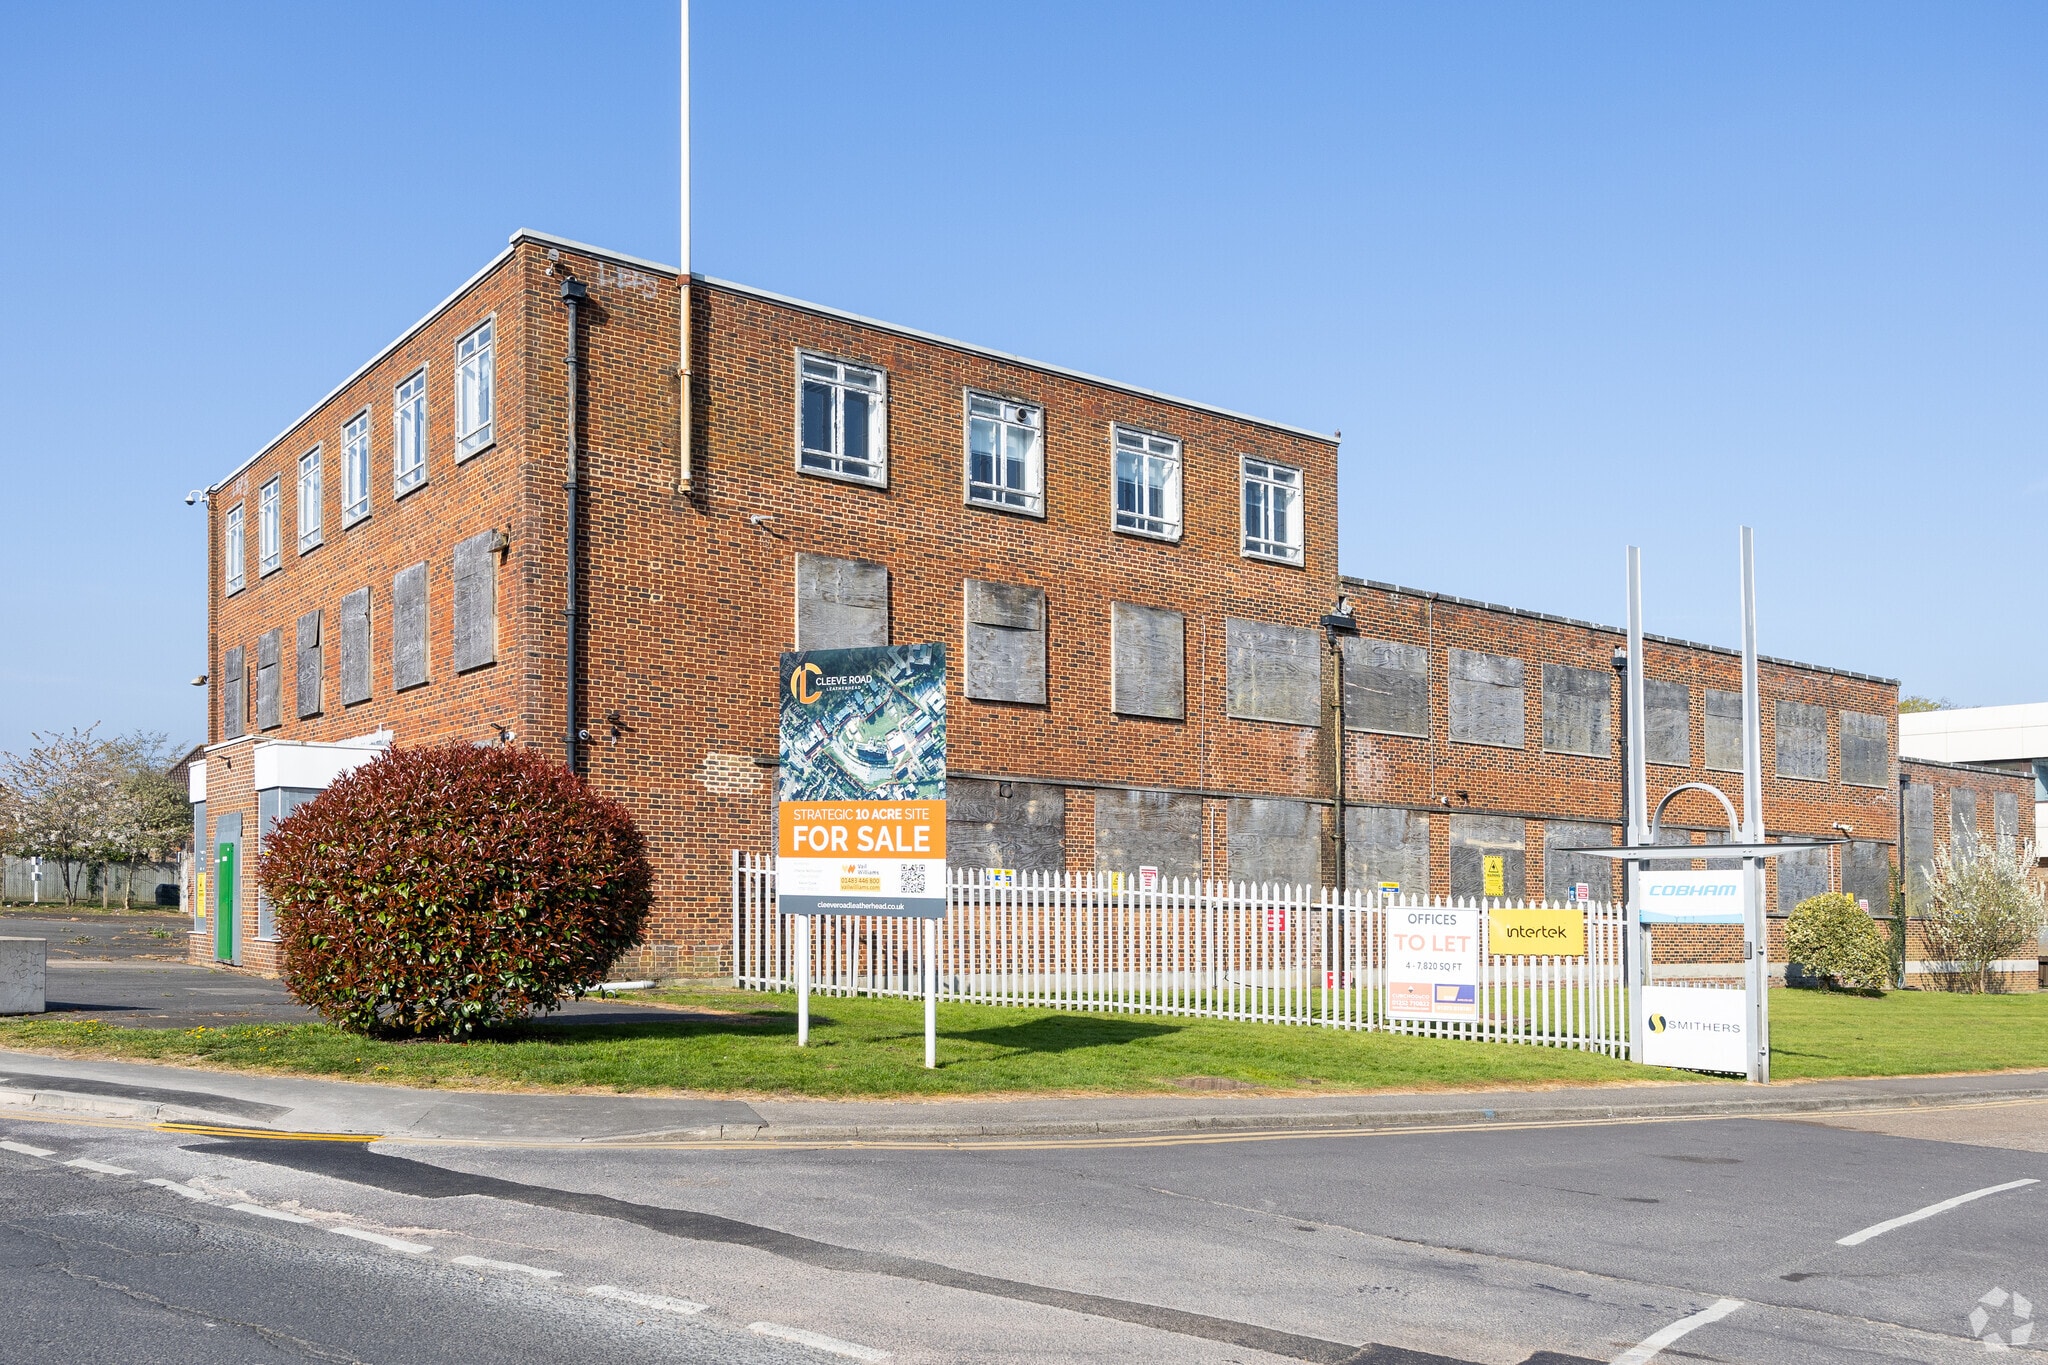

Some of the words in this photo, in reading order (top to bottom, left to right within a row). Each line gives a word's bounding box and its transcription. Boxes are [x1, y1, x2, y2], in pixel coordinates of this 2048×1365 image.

[815, 676, 847, 686] CLEEVE
[848, 674, 873, 684] ROAD
[793, 808, 853, 820] STRATEGIC
[855, 808, 870, 820] 10
[871, 808, 903, 820] ACRE
[904, 808, 930, 820] SITE
[793, 825, 849, 851] FOR
[857, 825, 931, 852] SALE
[1649, 884, 1737, 897] COBHAM
[817, 901, 905, 910] cleeveroadleatherhead.co.uk
[1407, 913, 1457, 926] OFFICES
[1506, 924, 1567, 939] intertek
[1393, 934, 1426, 951] TO
[1432, 935, 1472, 953] LET
[1417, 962, 1438, 971] 7,820
[1439, 963, 1451, 972] SQ
[1452, 963, 1463, 971] FT
[1668, 1020, 1741, 1034] SMITHERS
